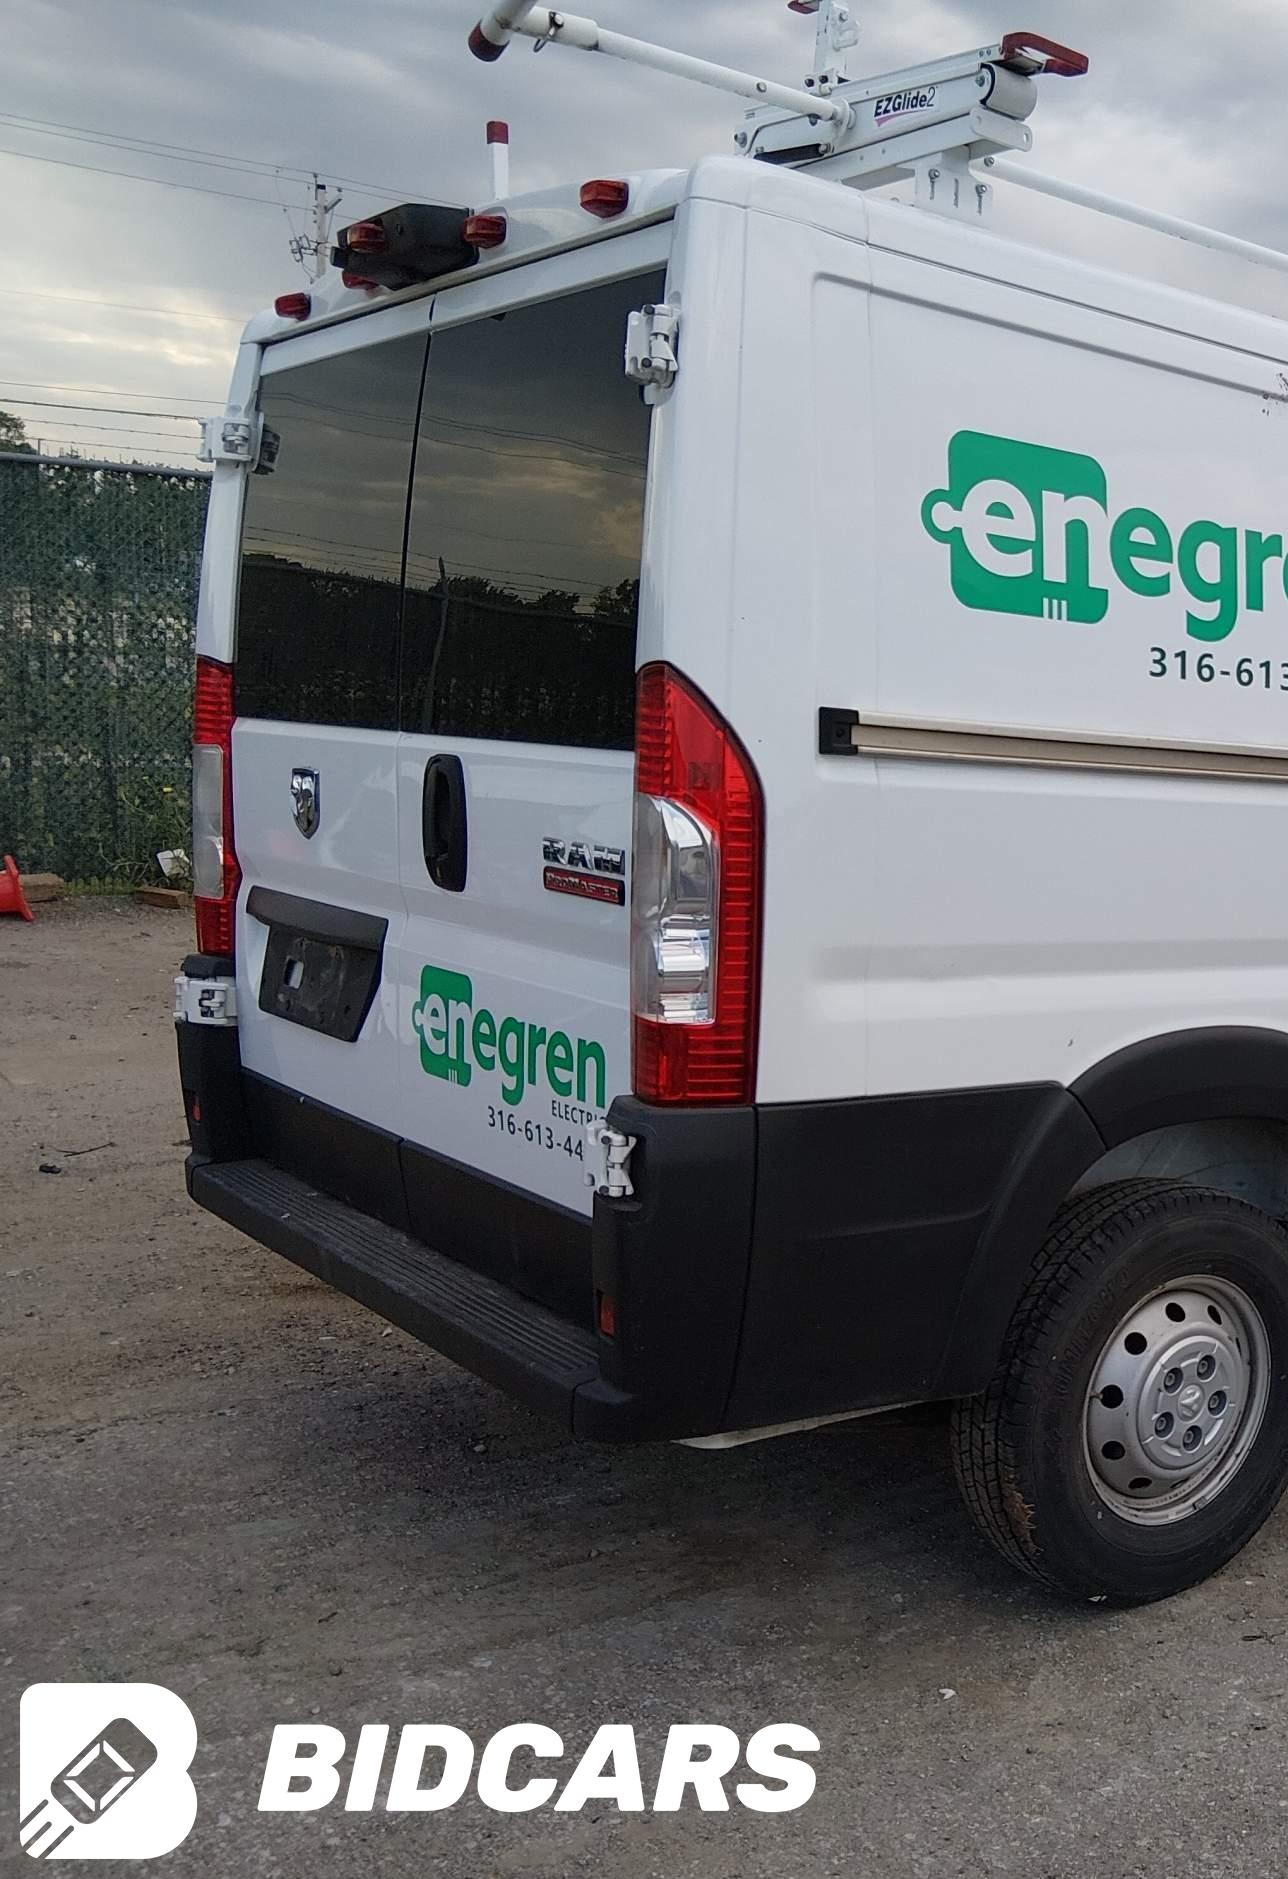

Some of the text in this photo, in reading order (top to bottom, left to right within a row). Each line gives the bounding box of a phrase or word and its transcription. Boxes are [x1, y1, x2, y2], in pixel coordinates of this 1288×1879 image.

[873, 86, 936, 118] EZGlide2
[542, 837, 625, 875] RAM
[422, 991, 606, 1108] enegren
[551, 1100, 607, 1127] ELECTR
[487, 1105, 584, 1162] 316-613-44
